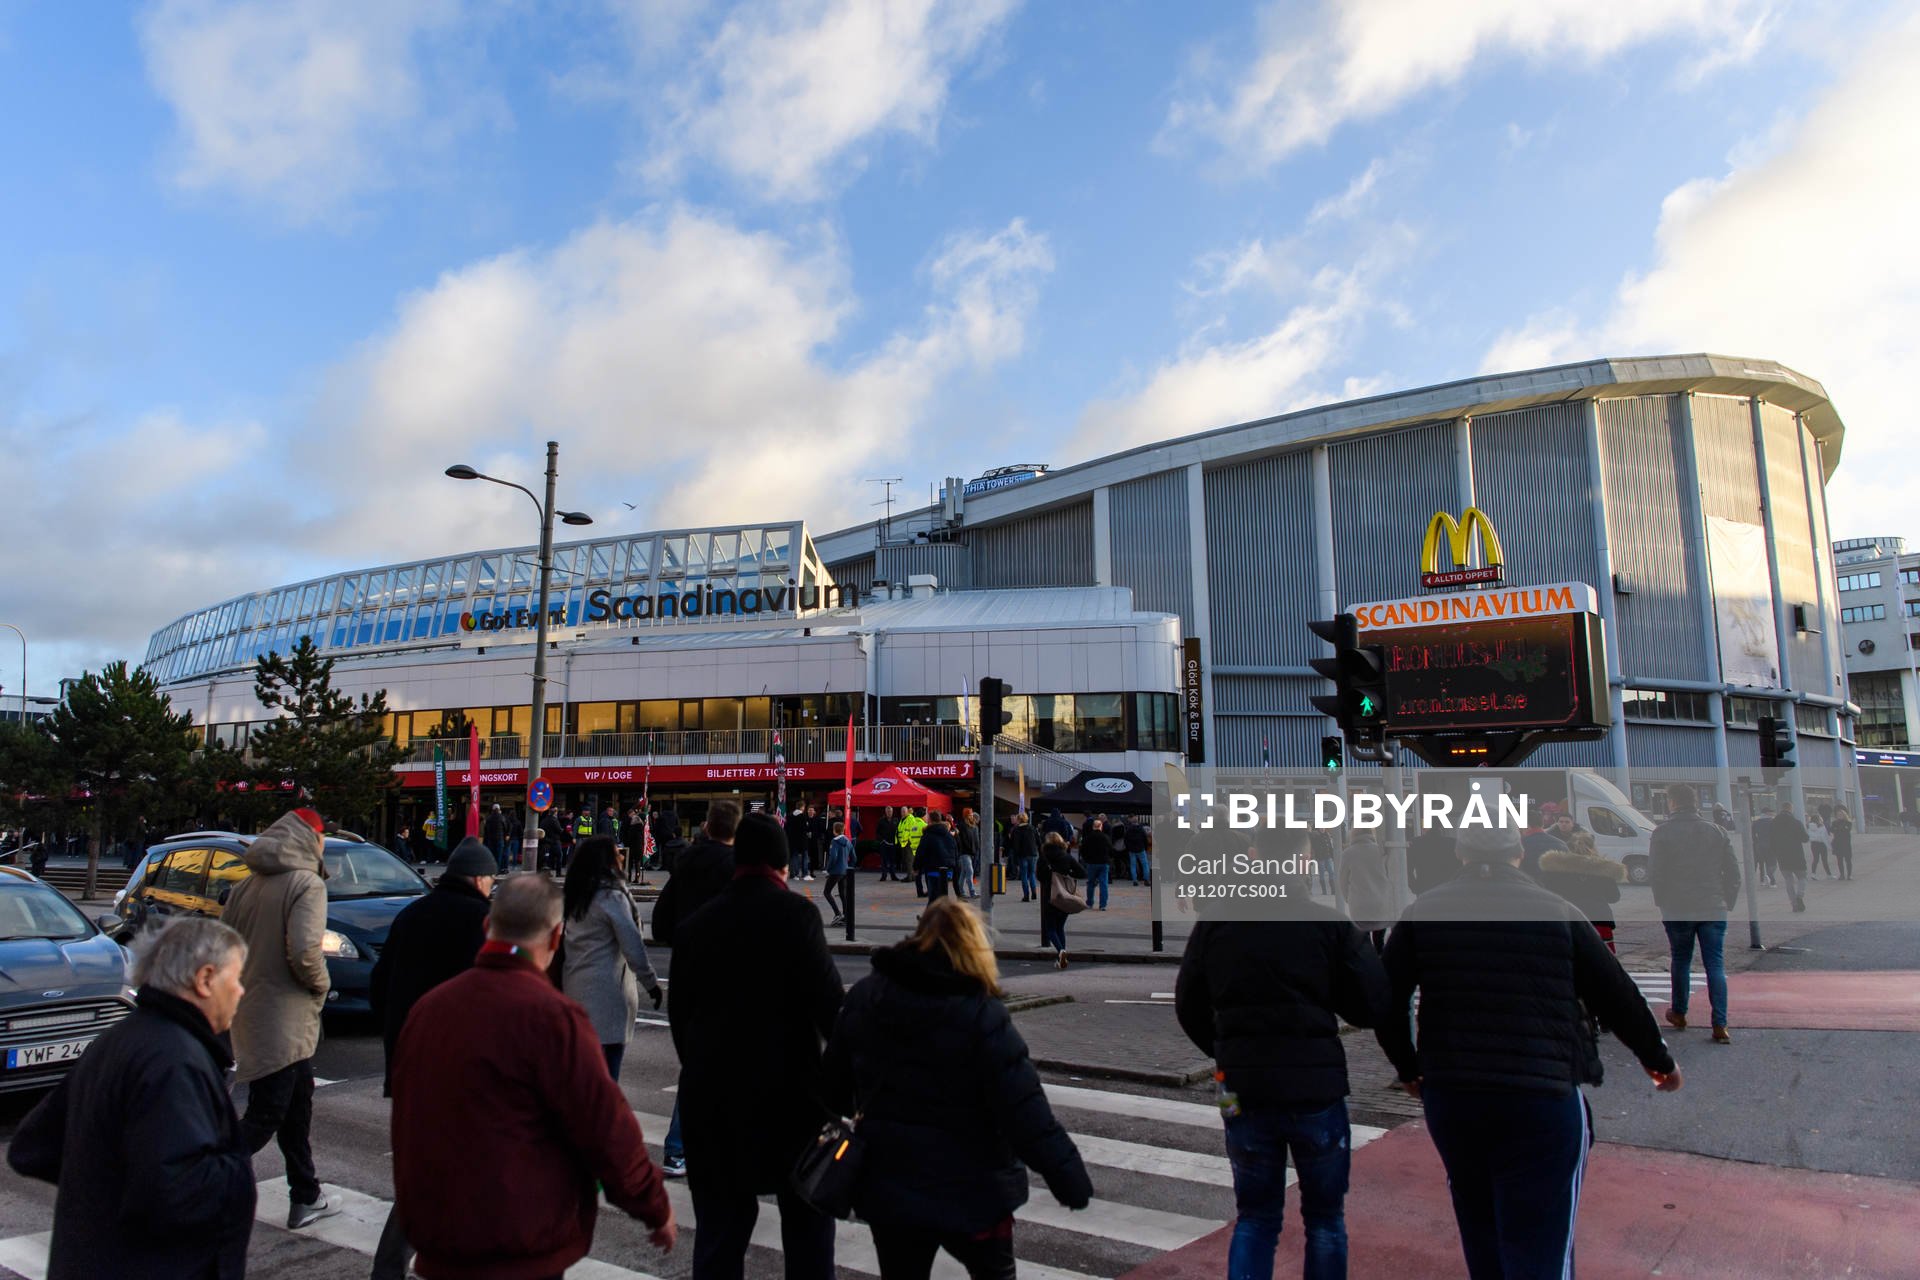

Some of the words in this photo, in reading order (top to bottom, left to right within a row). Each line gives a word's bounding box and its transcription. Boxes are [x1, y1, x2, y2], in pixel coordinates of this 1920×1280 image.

[589, 579, 858, 621] Scandinavium
[1355, 586, 1576, 629] SCANDINAVIUM
[480, 609, 512, 631] Got
[516, 605, 566, 628] Evnt
[1188, 660, 1198, 686] Glöd
[1189, 688, 1199, 709] Kök
[1190, 711, 1199, 719] &
[1190, 722, 1200, 742] Bar
[462, 773, 519, 783] SÄNGSKORT
[584, 772, 600, 780] VIP
[601, 772, 606, 780] /
[608, 771, 632, 780] LOGE
[707, 768, 755, 778] BILJETTER
[765, 767, 805, 777] TICETS
[24, 1046, 55, 1064] YWF
[61, 1042, 82, 1059] 24
